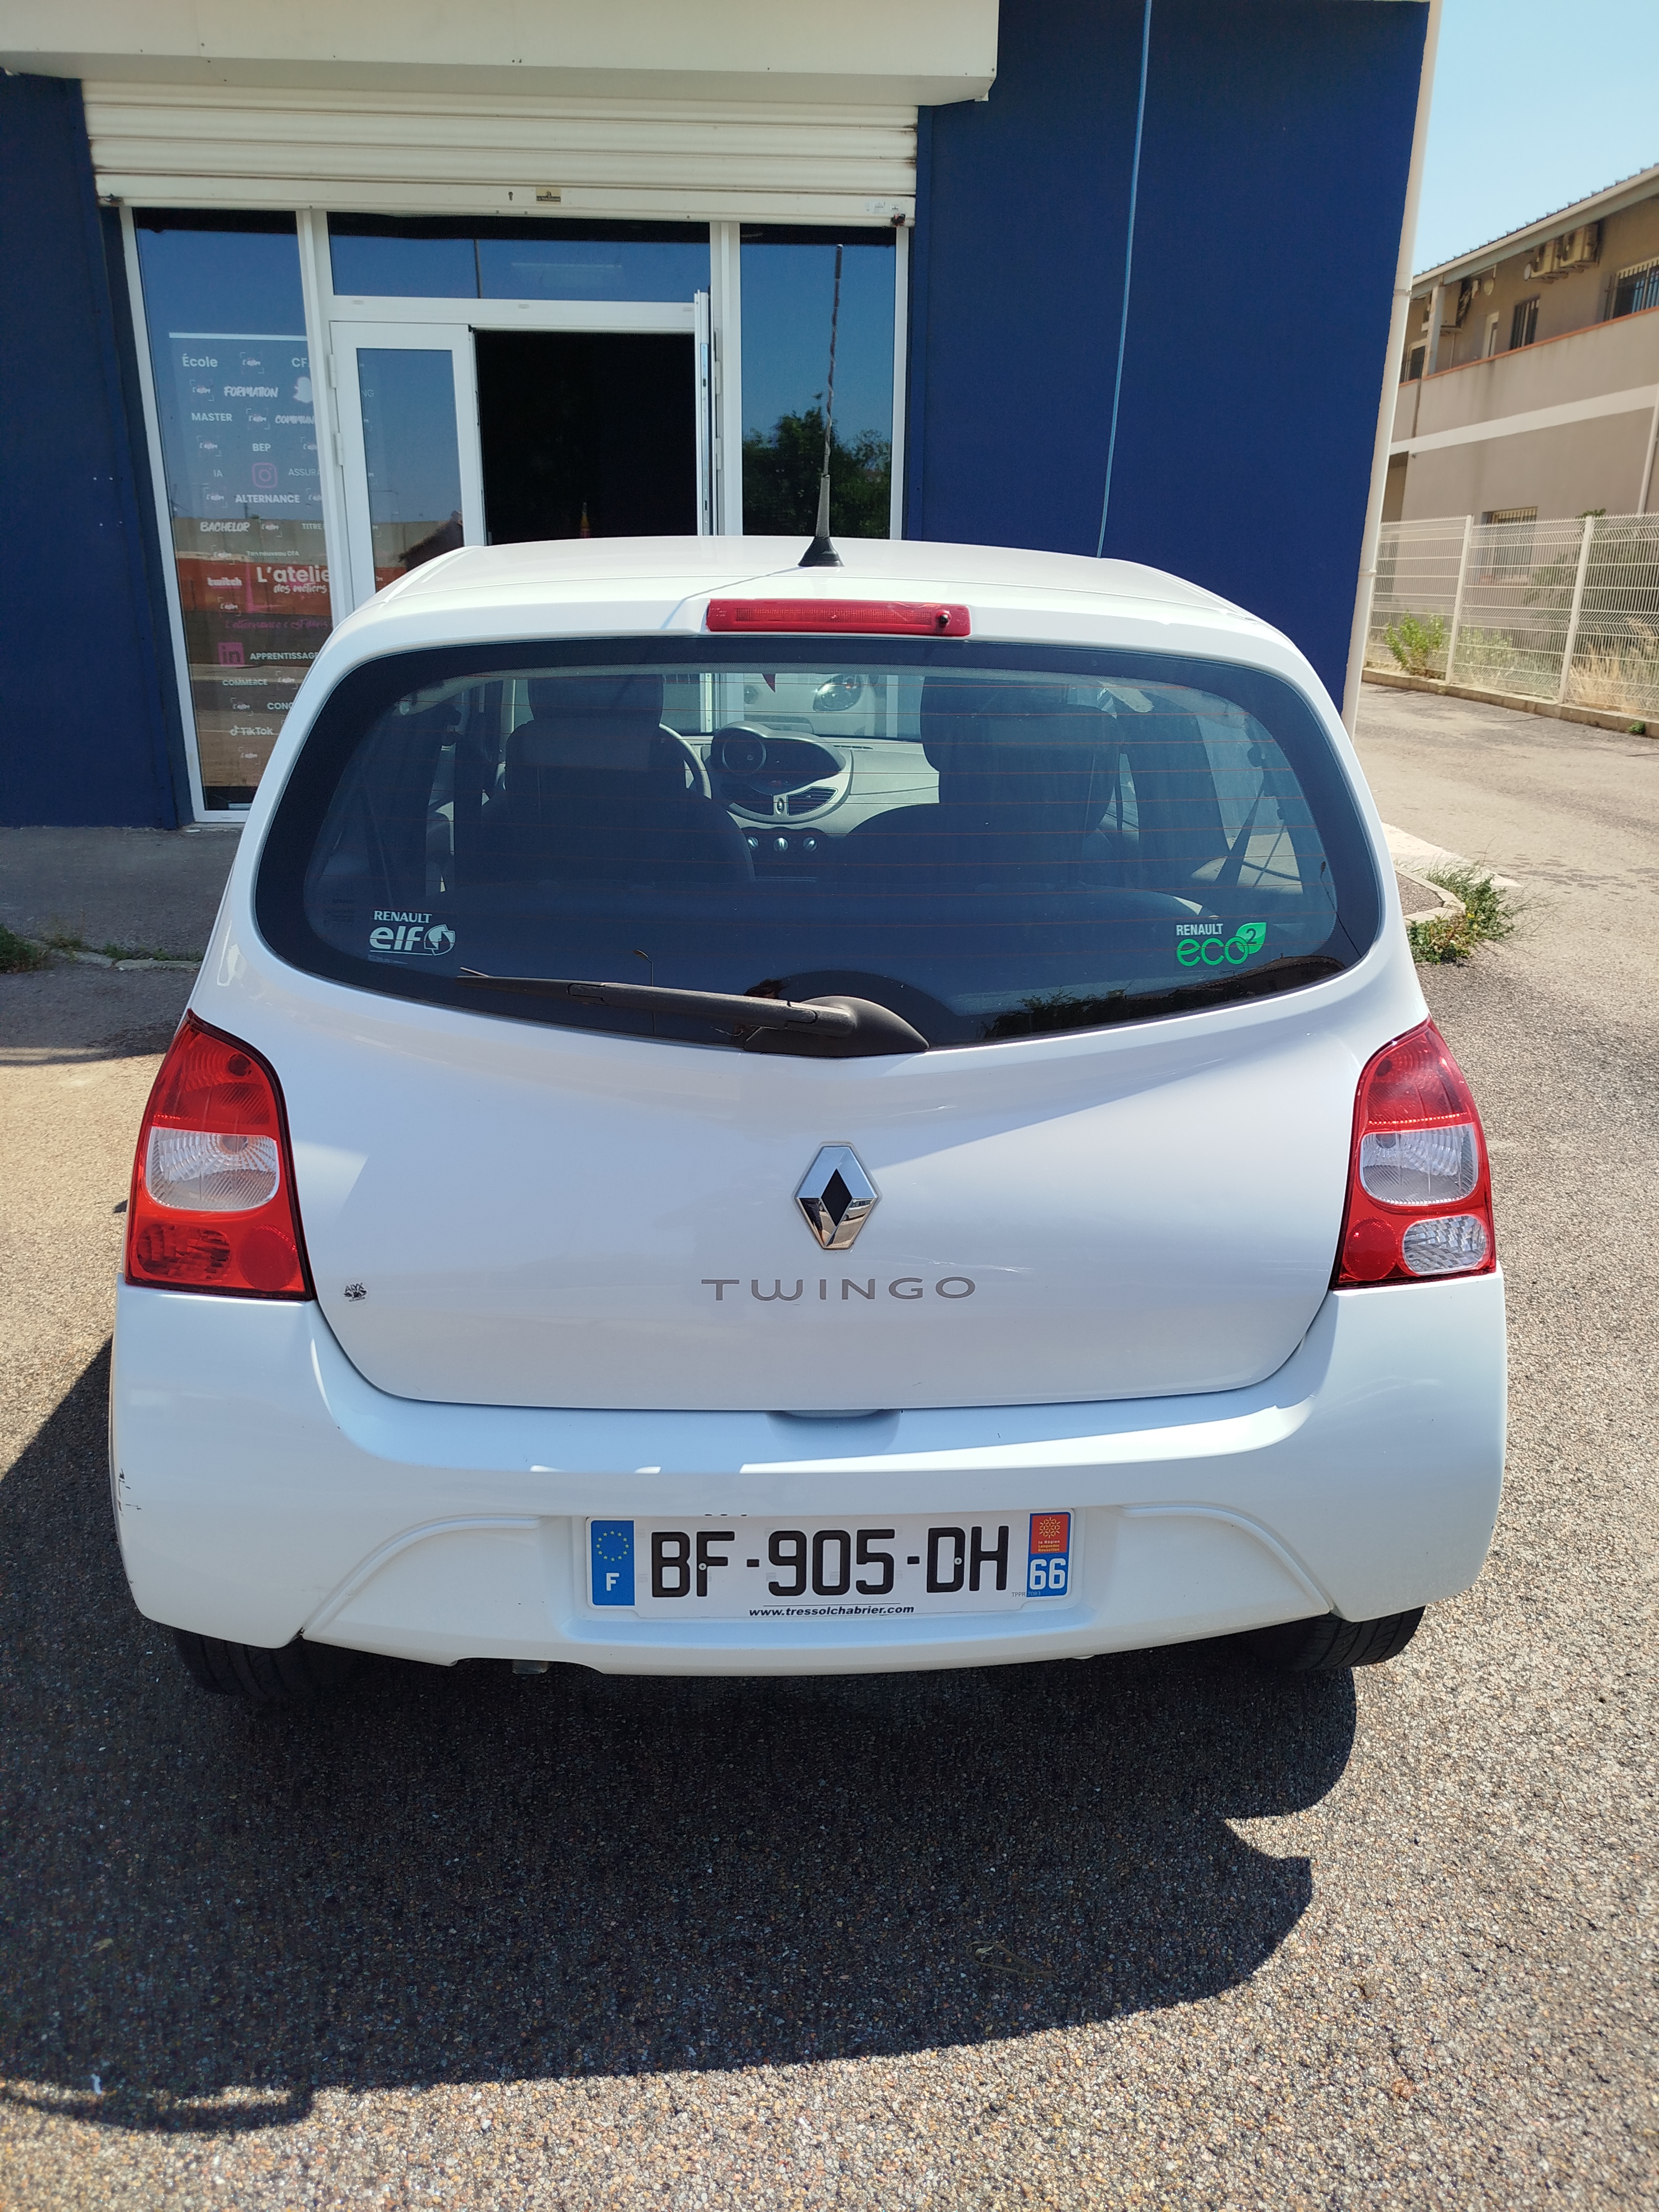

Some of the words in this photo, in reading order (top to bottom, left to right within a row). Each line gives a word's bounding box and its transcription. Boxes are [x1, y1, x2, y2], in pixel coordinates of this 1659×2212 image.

[182, 353, 218, 368] École
[291, 357, 310, 368] CF
[224, 386, 279, 398] FORMATION
[191, 413, 233, 422] MASTER
[252, 444, 271, 452] BEP
[235, 494, 300, 503] ALTERNANCE
[200, 521, 251, 533] BACHELOR
[207, 577, 242, 586] twitch
[274, 584, 290, 594] des
[240, 727, 273, 735] TikTok
[374, 910, 432, 924] RENAULT
[1176, 924, 1223, 936] RENAULT
[369, 926, 424, 951] elf
[701, 1276, 976, 1301] TWINGO
[1030, 1558, 1066, 1590] 66
[606, 1573, 619, 1591] F
[749, 1605, 914, 1616] www.tressolchabrier.com
